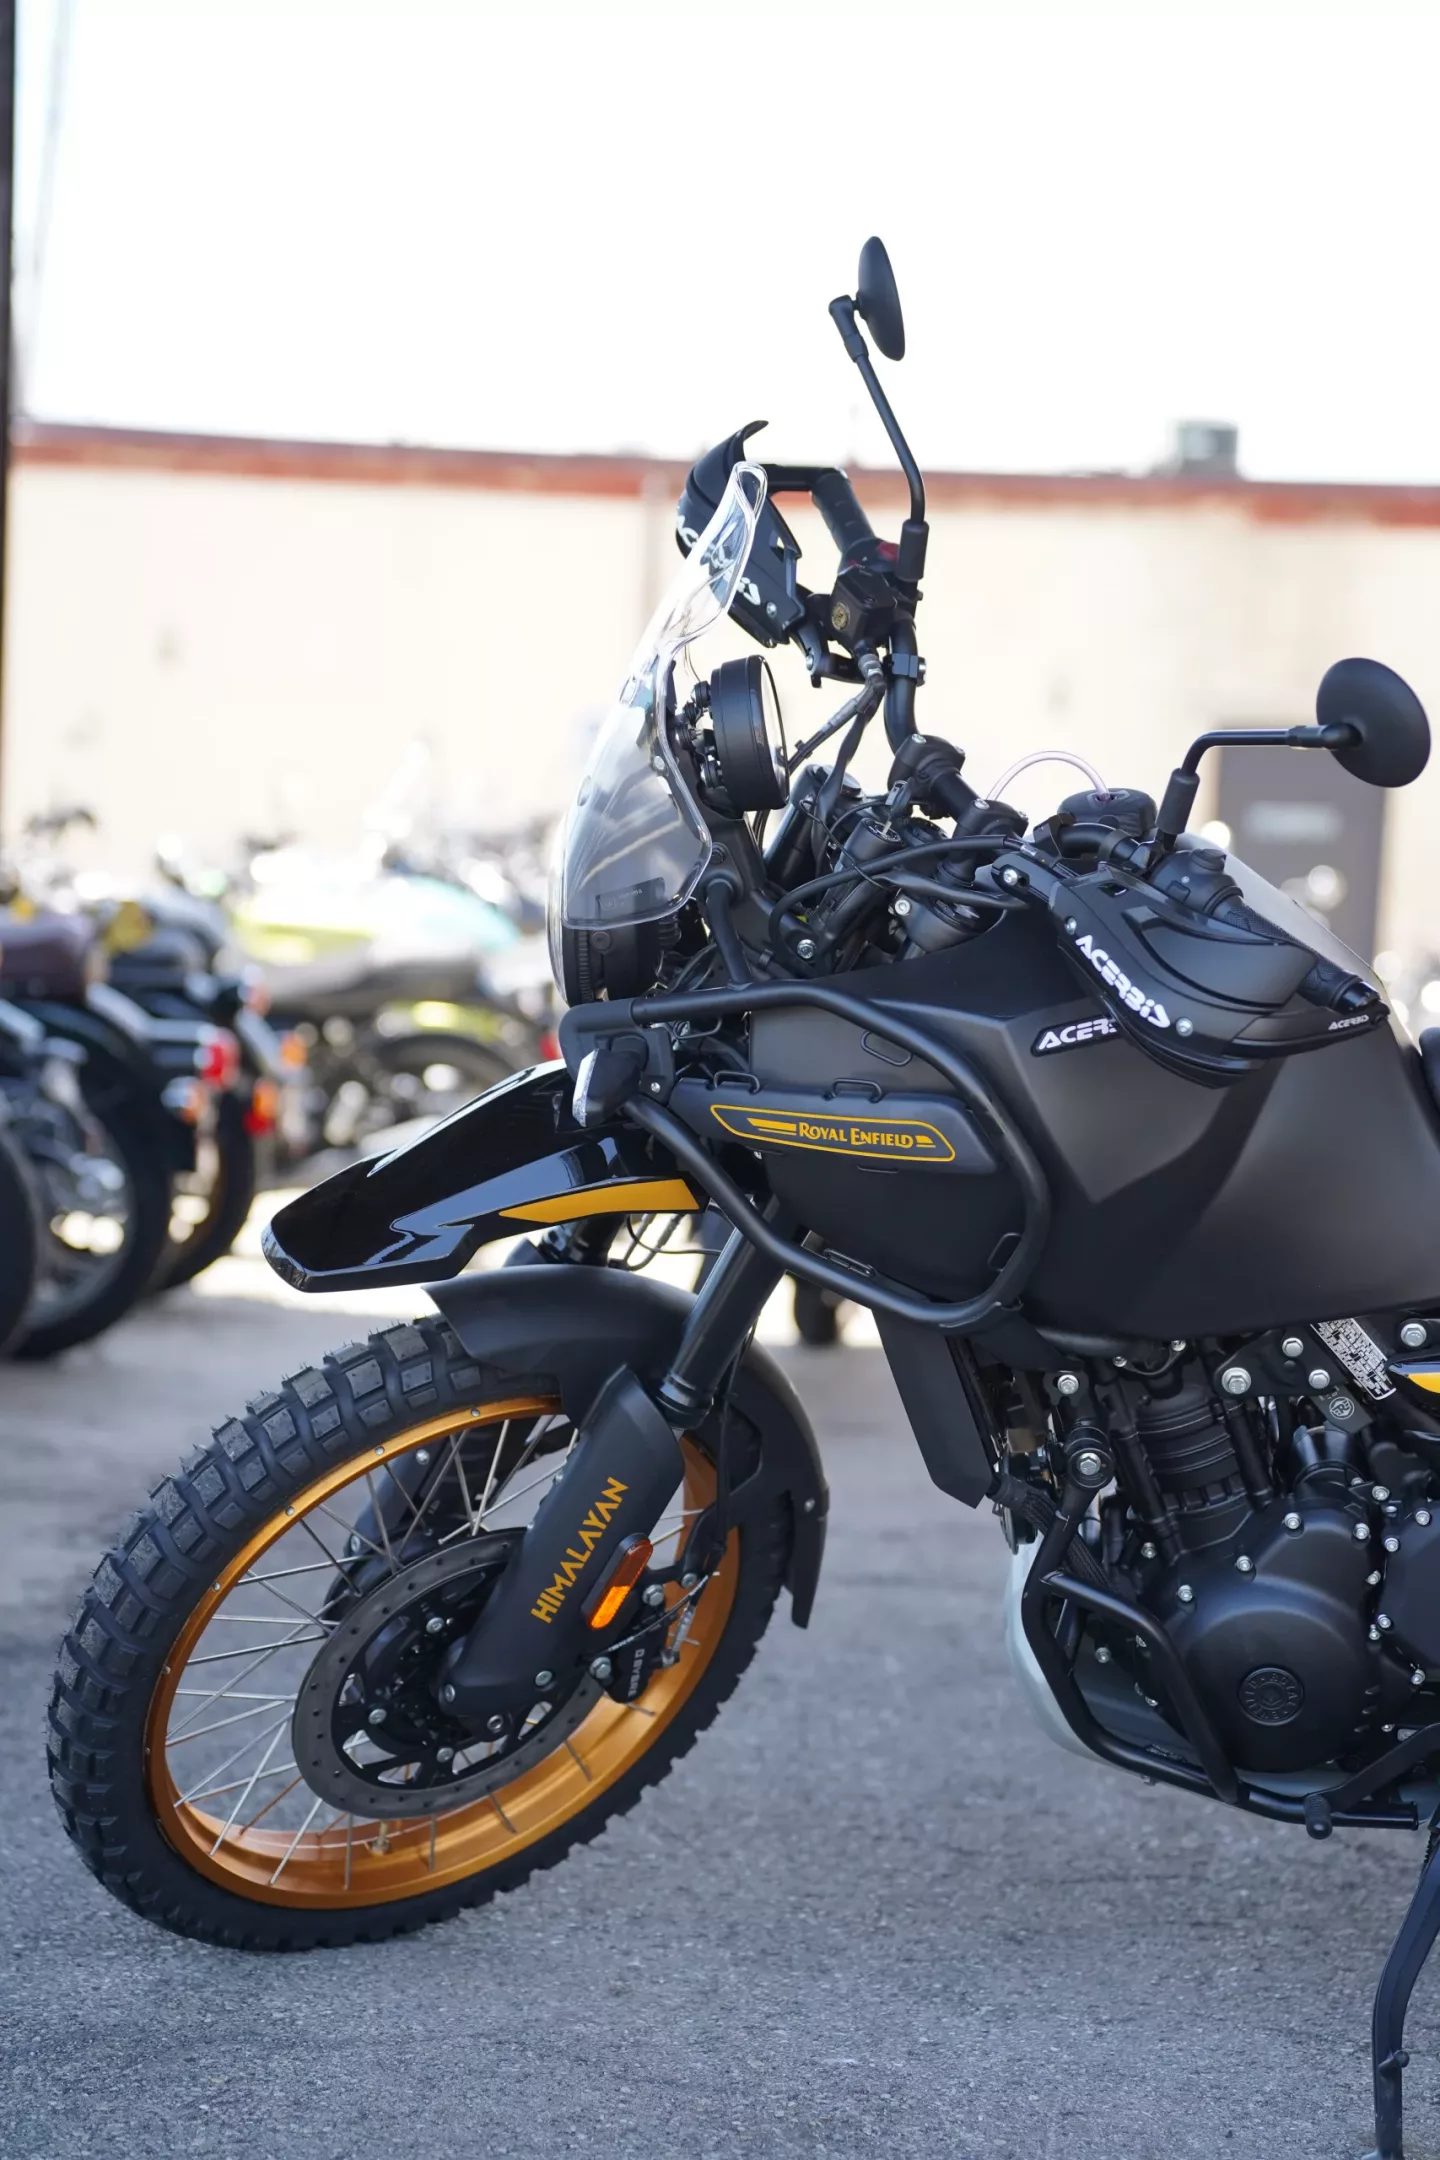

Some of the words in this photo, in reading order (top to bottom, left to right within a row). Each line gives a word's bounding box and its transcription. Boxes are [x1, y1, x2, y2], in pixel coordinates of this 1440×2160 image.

[798, 1121, 847, 1142] ROYAL
[850, 1127, 914, 1149] ENFIELD
[530, 1477, 629, 1624] HIMALAYAN
